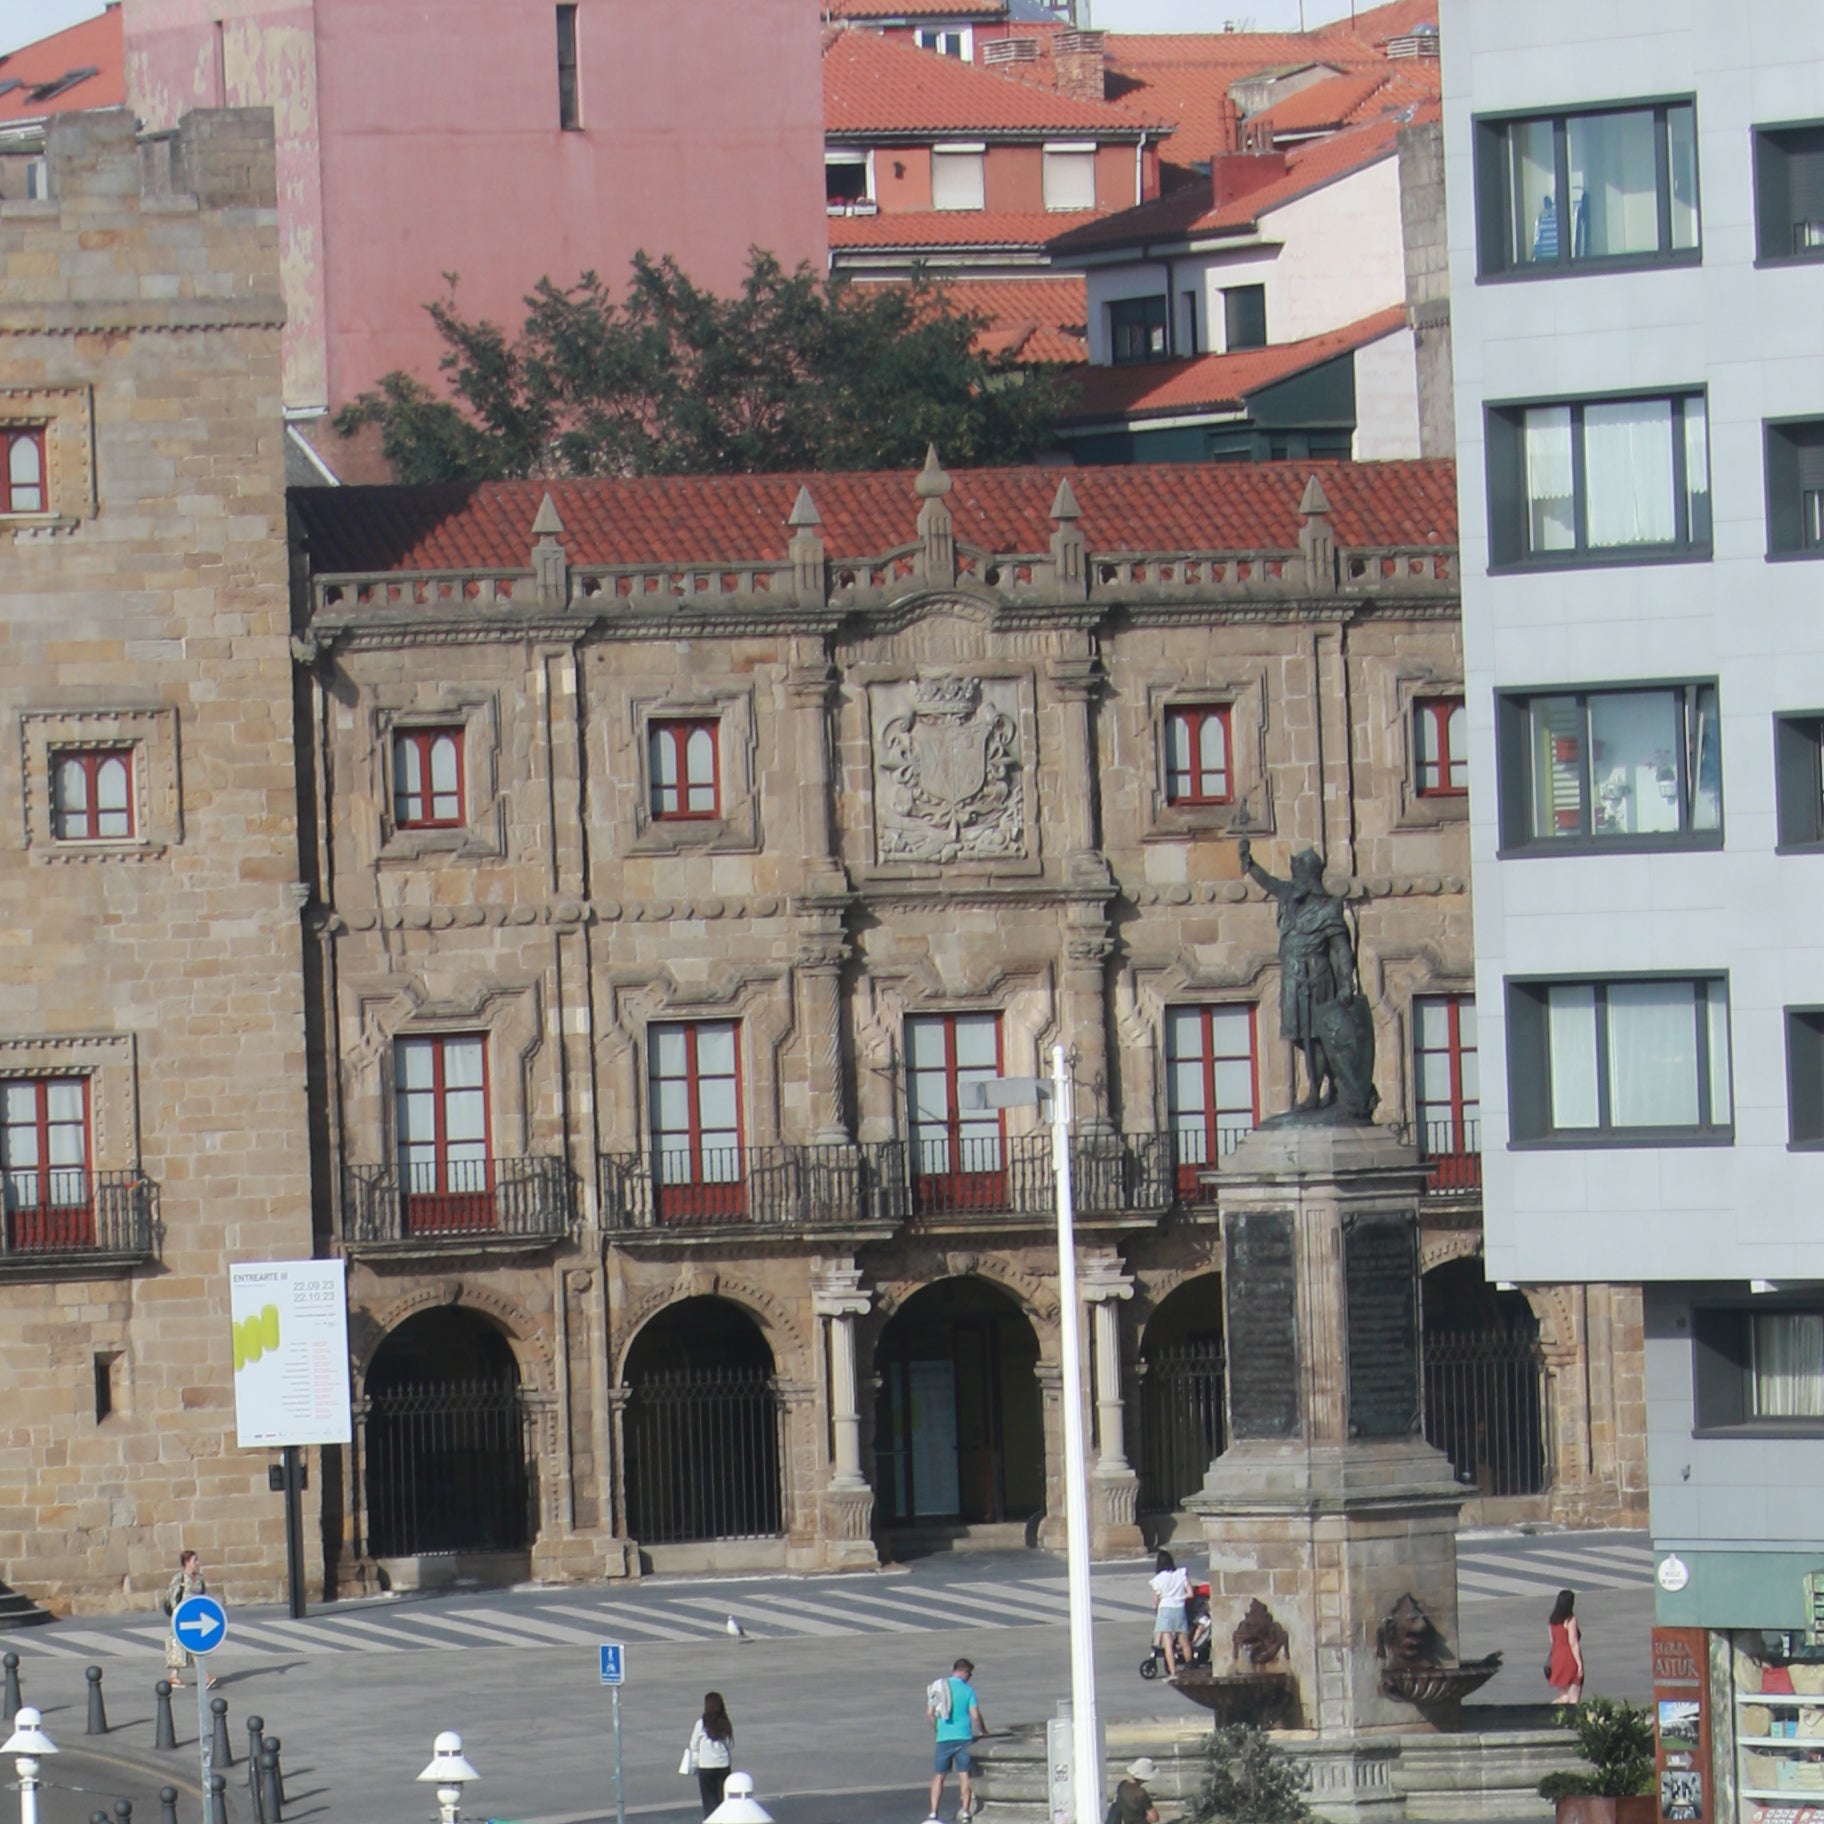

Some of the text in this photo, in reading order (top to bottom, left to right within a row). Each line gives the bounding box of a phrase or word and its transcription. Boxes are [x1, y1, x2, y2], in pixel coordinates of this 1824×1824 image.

[233, 1272, 278, 1283] ENTREARTE
[293, 1280, 334, 1291] 22.09.23
[294, 1291, 335, 1303] 22.10.23
[1654, 1657, 1700, 1678] ASTUR
